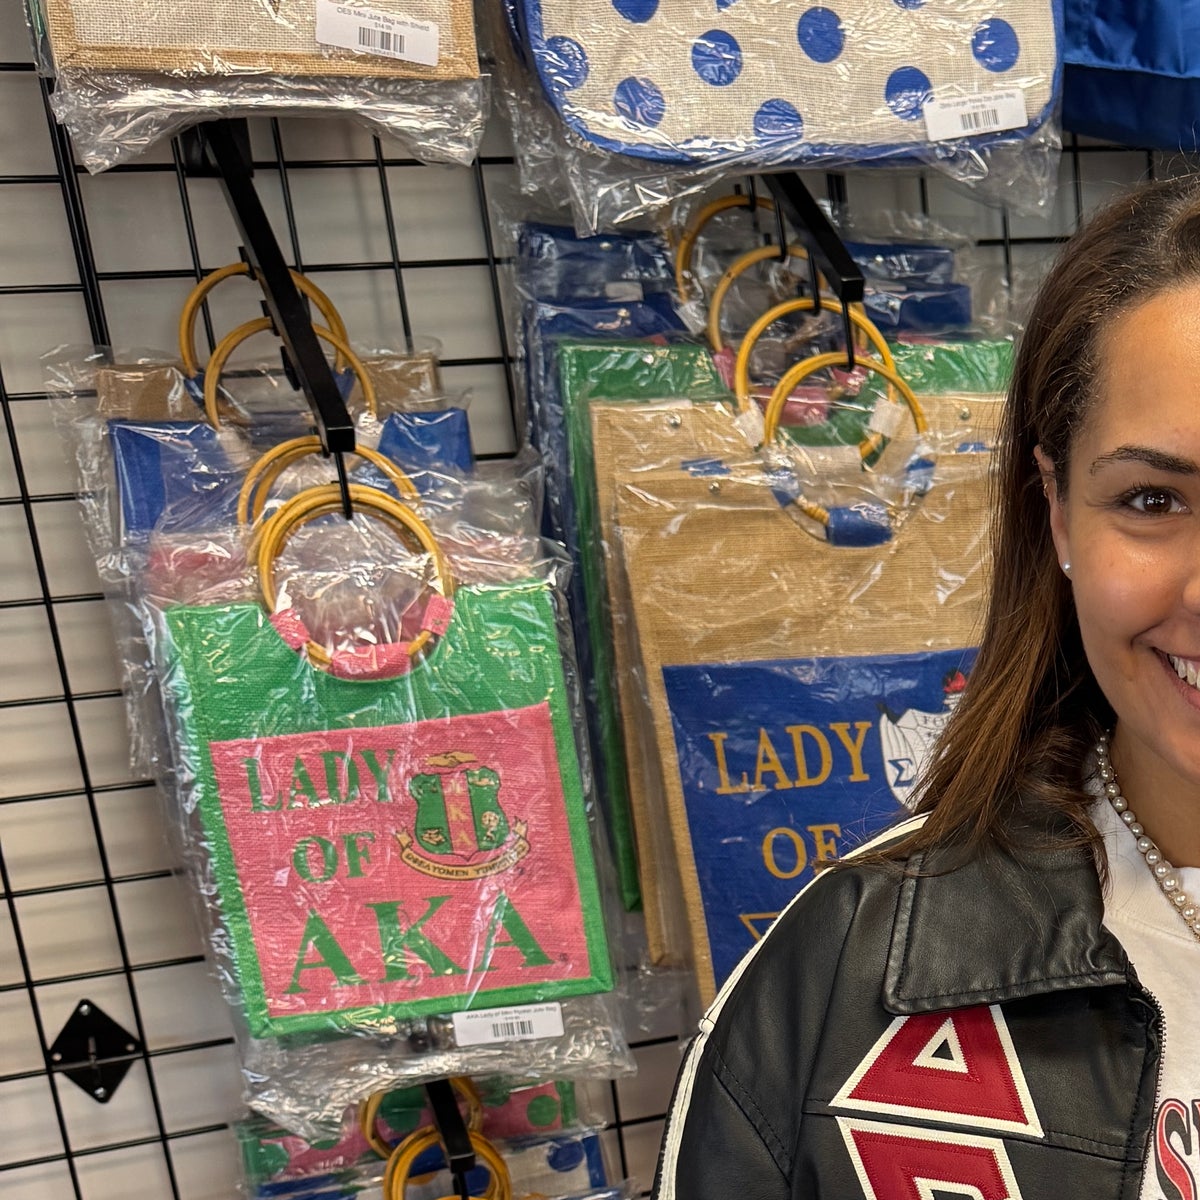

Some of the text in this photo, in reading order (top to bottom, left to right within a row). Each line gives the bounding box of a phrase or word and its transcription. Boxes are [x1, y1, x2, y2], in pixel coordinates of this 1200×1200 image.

[240, 749, 397, 814] LADY
[707, 721, 872, 795] LADY
[292, 831, 376, 883] OF
[762, 823, 842, 880] OF
